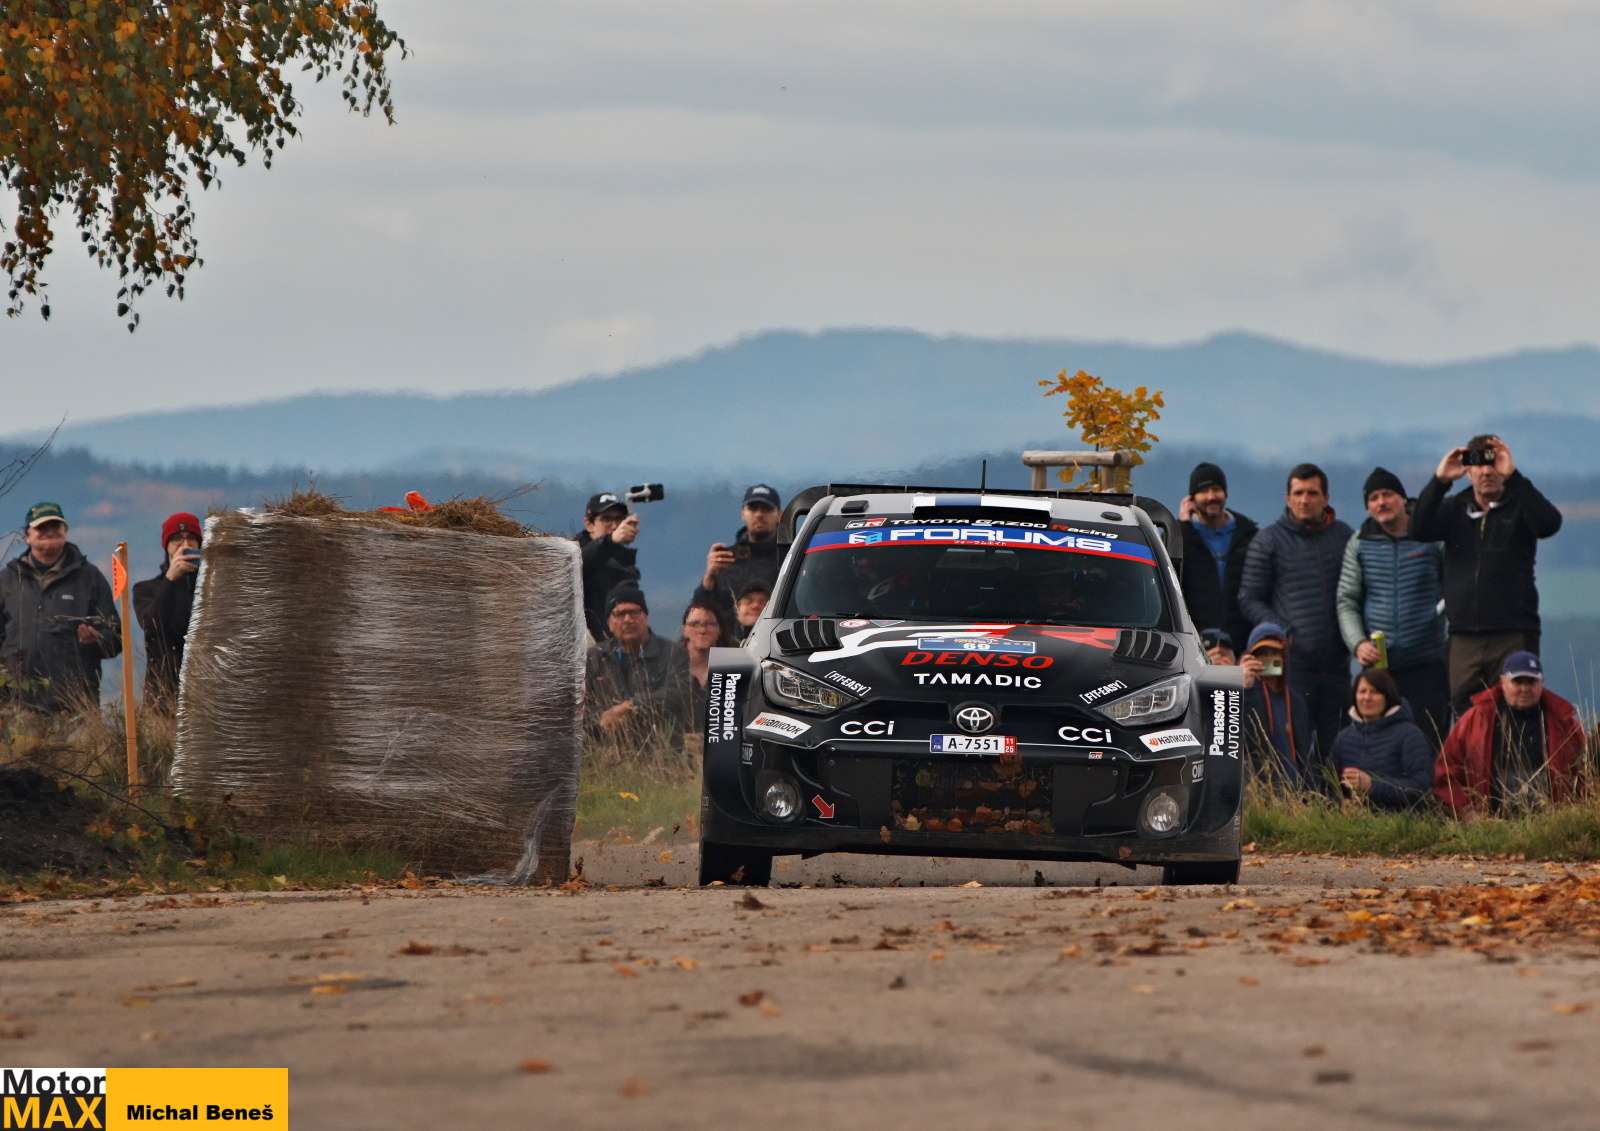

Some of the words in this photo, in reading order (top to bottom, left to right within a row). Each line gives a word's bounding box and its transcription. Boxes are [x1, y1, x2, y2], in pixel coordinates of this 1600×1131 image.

[890, 529, 1112, 552] FORUM8
[973, 519, 1048, 529] GAZOO
[1051, 523, 1119, 539] Racing
[901, 651, 1054, 669] DENSO
[913, 673, 1042, 689] TAMADIC
[708, 673, 723, 744] AUTOMOTIVE
[722, 673, 741, 741] Panasonic
[1209, 689, 1225, 756] Panasonic
[1227, 690, 1240, 760] AUTOMOTIVE
[948, 737, 999, 751] A-7551
